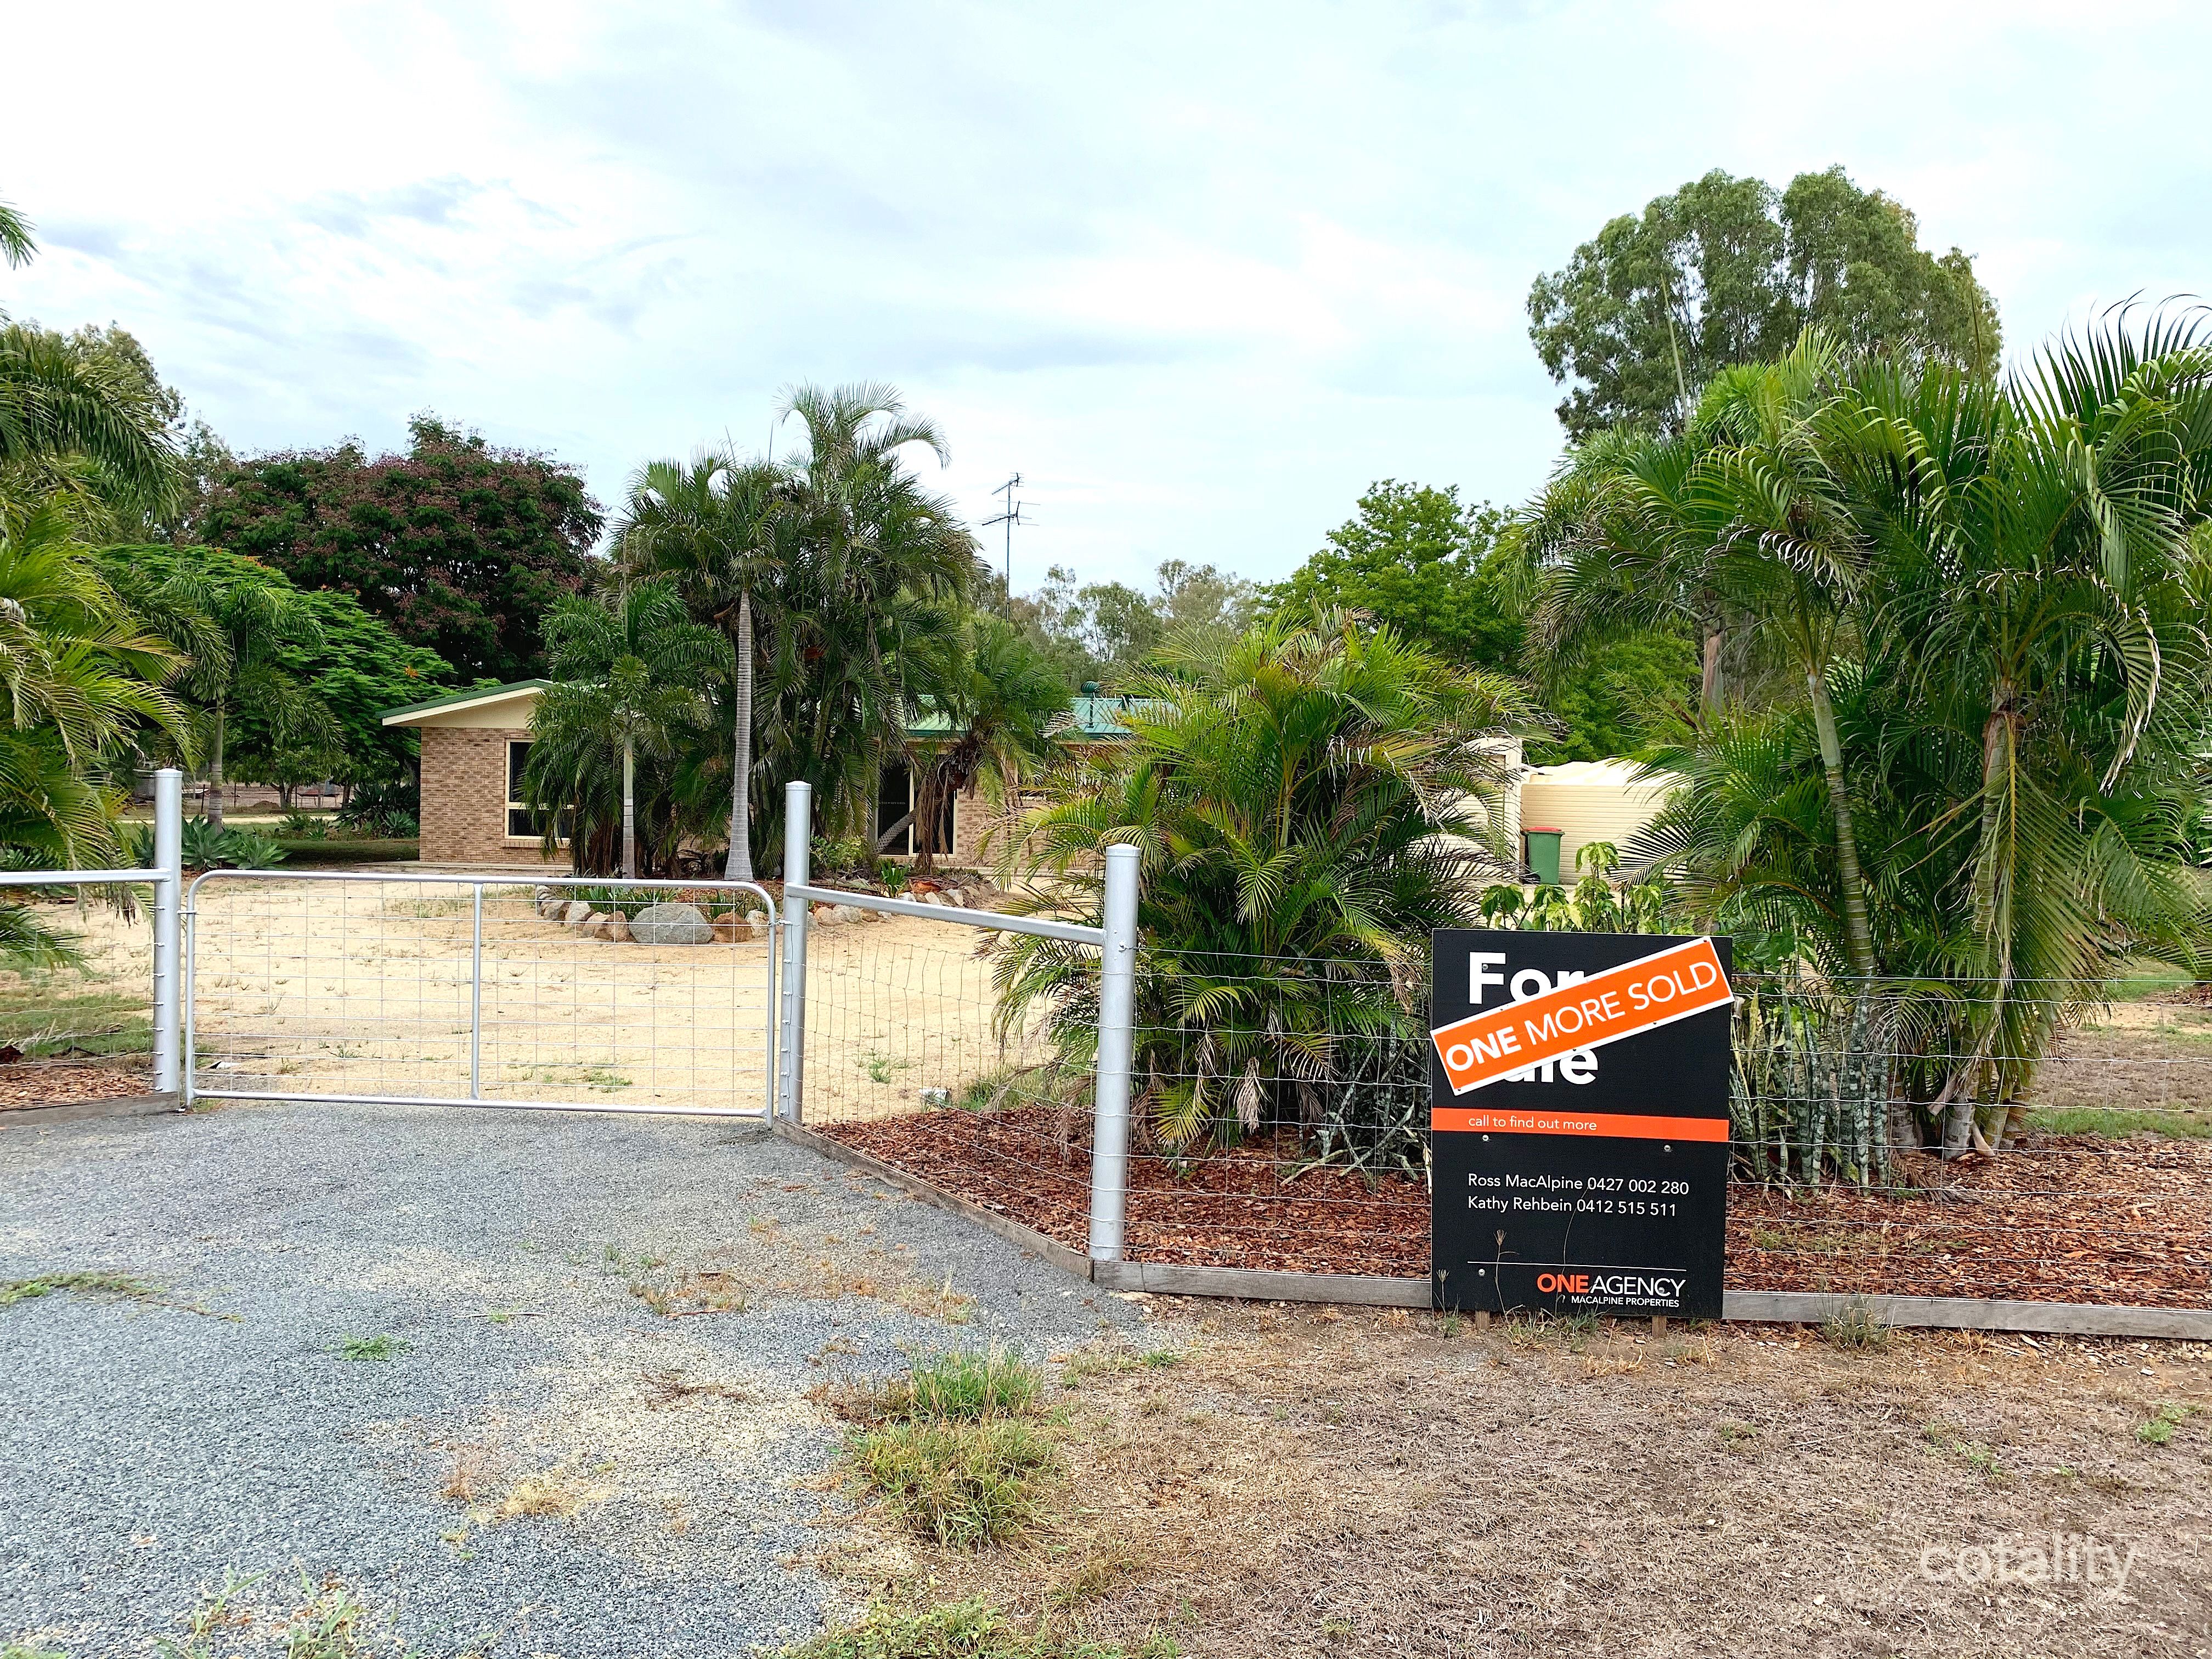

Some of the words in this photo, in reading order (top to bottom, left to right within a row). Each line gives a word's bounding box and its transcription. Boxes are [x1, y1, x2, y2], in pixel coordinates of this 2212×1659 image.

[1446, 1026, 1522, 1071] ONE
[1524, 991, 1626, 1045] MORE
[1627, 961, 1717, 1010] SOLD
[1468, 1114, 1489, 1127] call
[1492, 1117, 1506, 1127] to
[1509, 1115, 1534, 1128] find
[1537, 1119, 1560, 1129] out
[1563, 1121, 1598, 1131] more
[1468, 1173, 1502, 1187] Ross
[1505, 1174, 1583, 1192] MacAlpine
[1587, 1177, 1624, 1192] 0427
[1628, 1179, 1657, 1193] 002
[1661, 1181, 1689, 1195] 280
[1468, 1195, 1509, 1213] Kathy
[1513, 1197, 1572, 1211] Rehbein
[1577, 1199, 1613, 1213] 0412
[1618, 1201, 1646, 1215] 515
[1650, 1203, 1677, 1217] 511
[1571, 1295, 1624, 1305] MACALPINE
[1626, 1297, 1679, 1308] PROPERTIES
